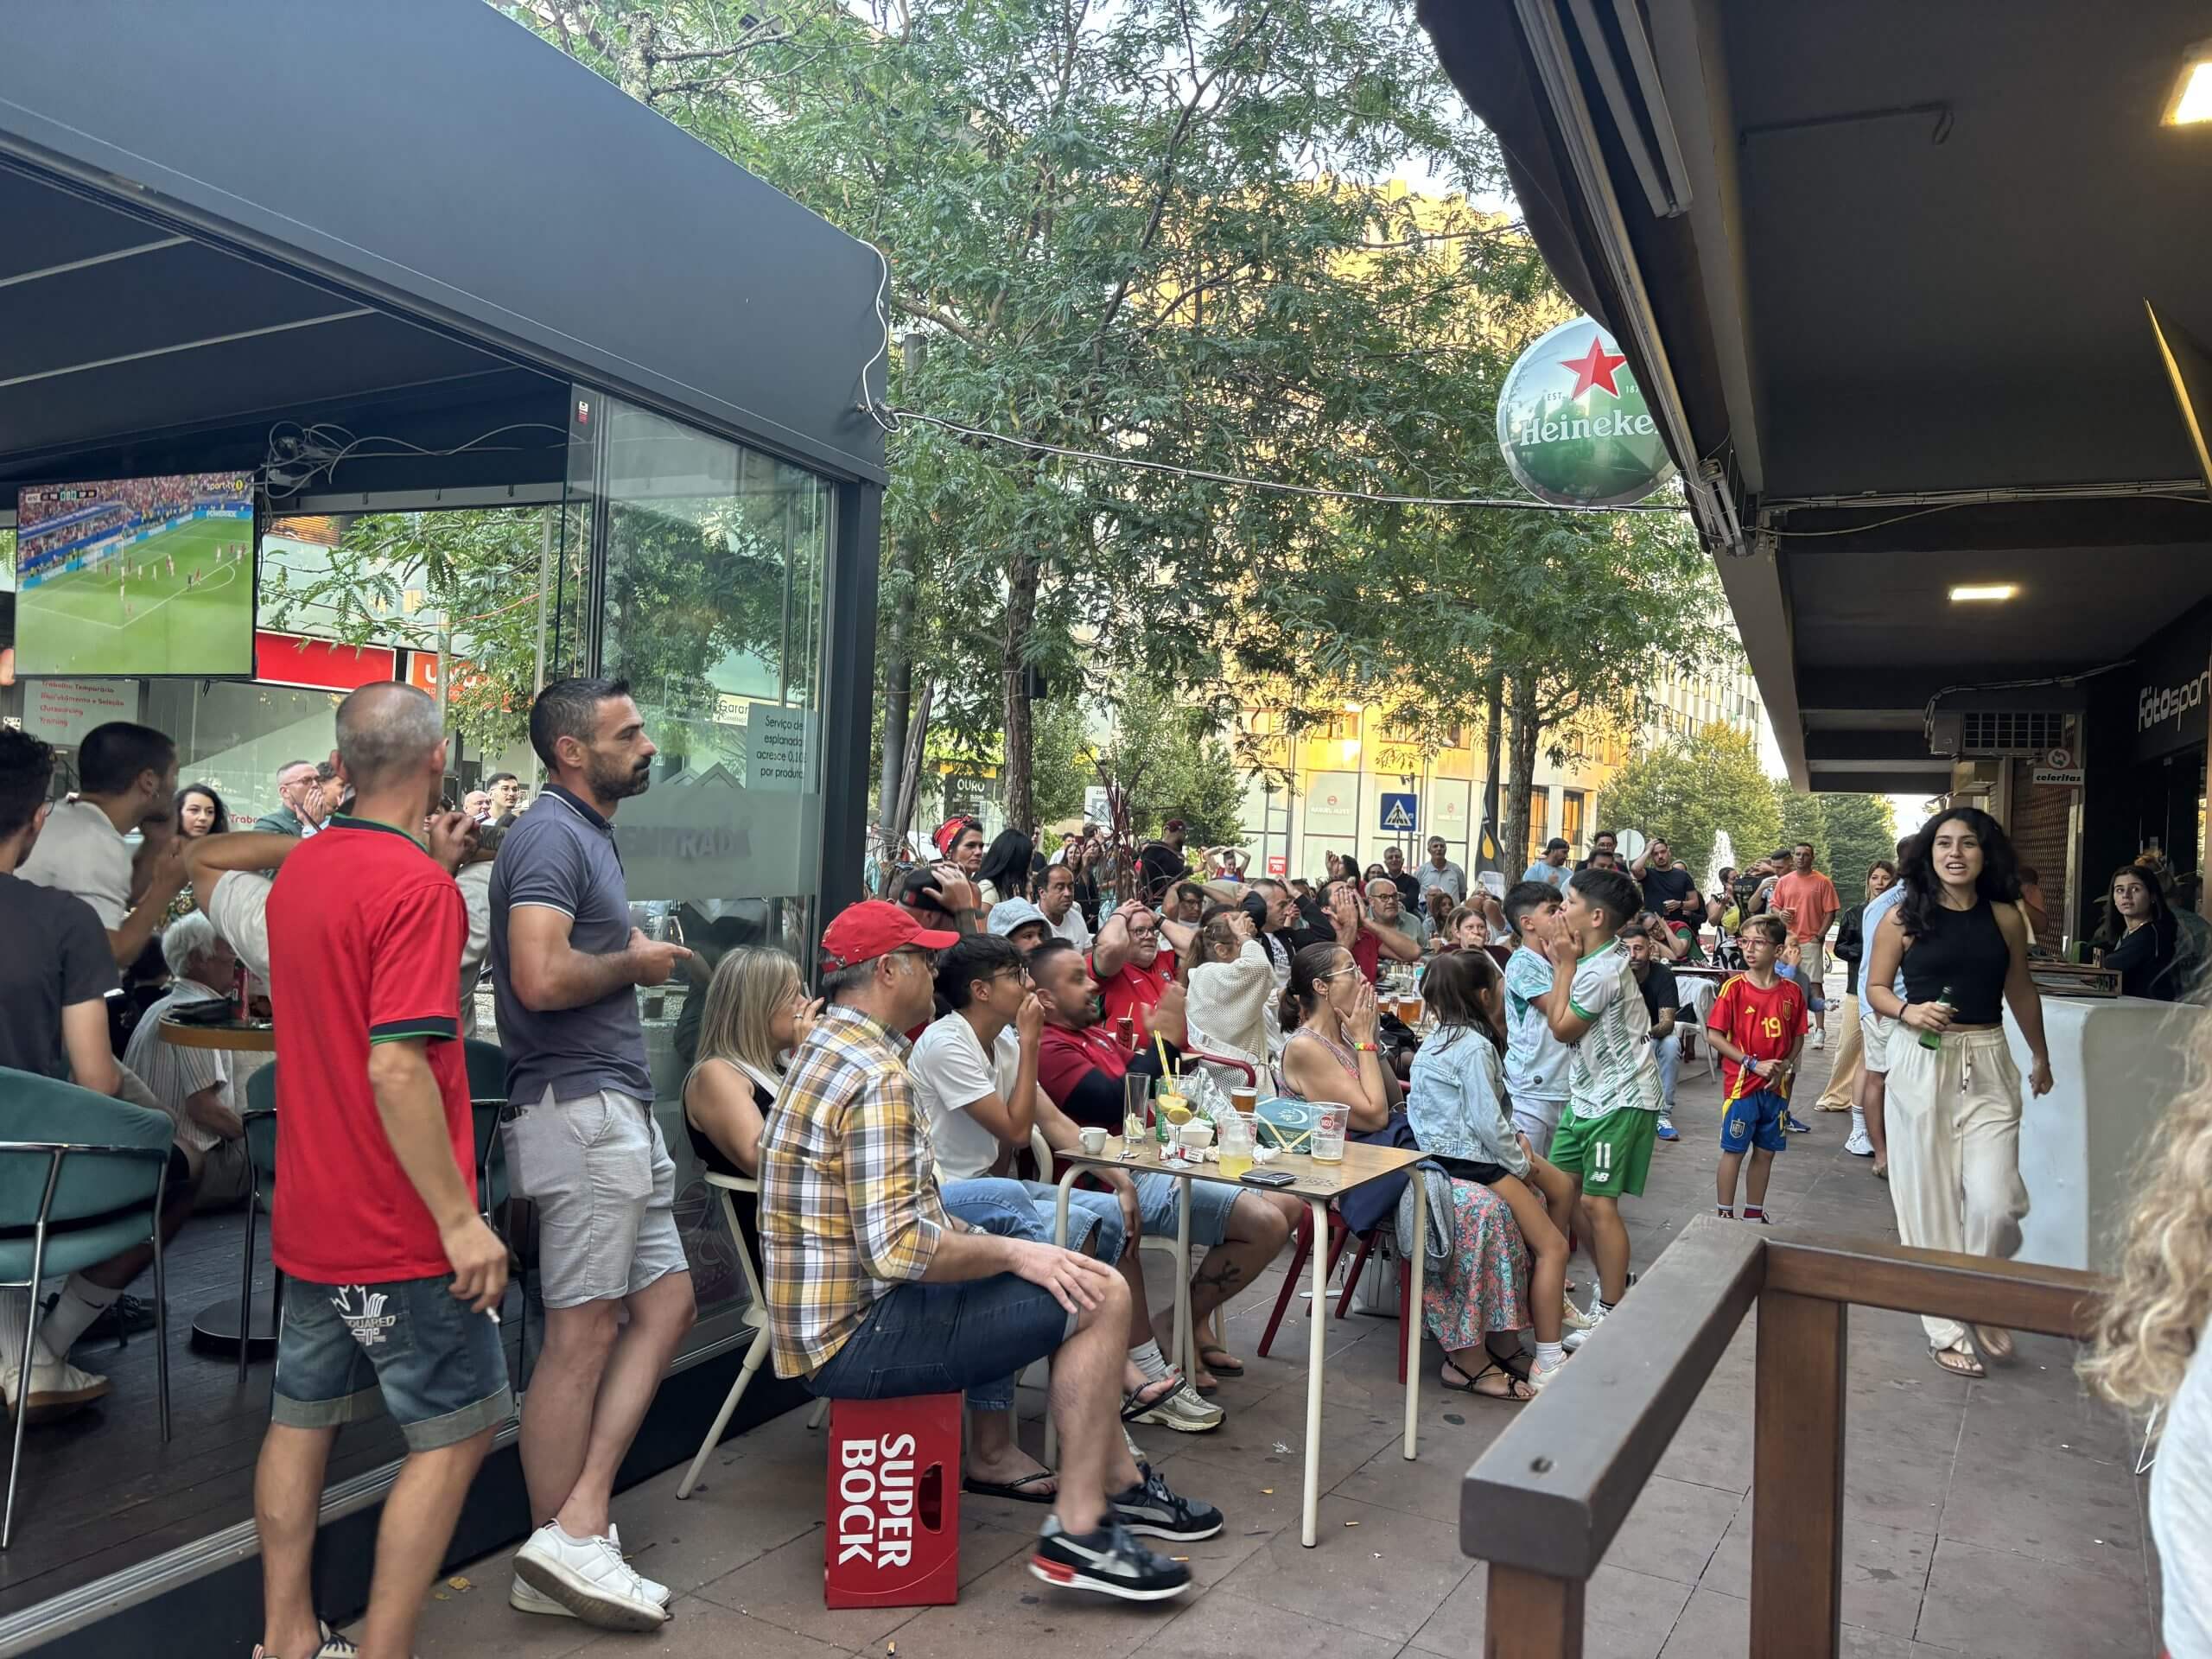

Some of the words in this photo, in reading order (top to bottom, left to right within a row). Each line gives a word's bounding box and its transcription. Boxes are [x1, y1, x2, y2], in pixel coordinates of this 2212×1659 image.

[1625, 385, 1641, 395] 187
[1519, 409, 1661, 447] Heineke
[765, 715, 792, 730] Serviço
[794, 718, 804, 731] de
[764, 734, 803, 748] esplanada
[756, 751, 786, 761] acresce
[760, 767, 773, 779] por
[957, 779, 985, 792] OURO
[1761, 1017, 1782, 1039] 19
[1595, 1142, 1611, 1169] 11
[838, 1440, 877, 1566] BOCK
[877, 1433, 916, 1570] SUPER
